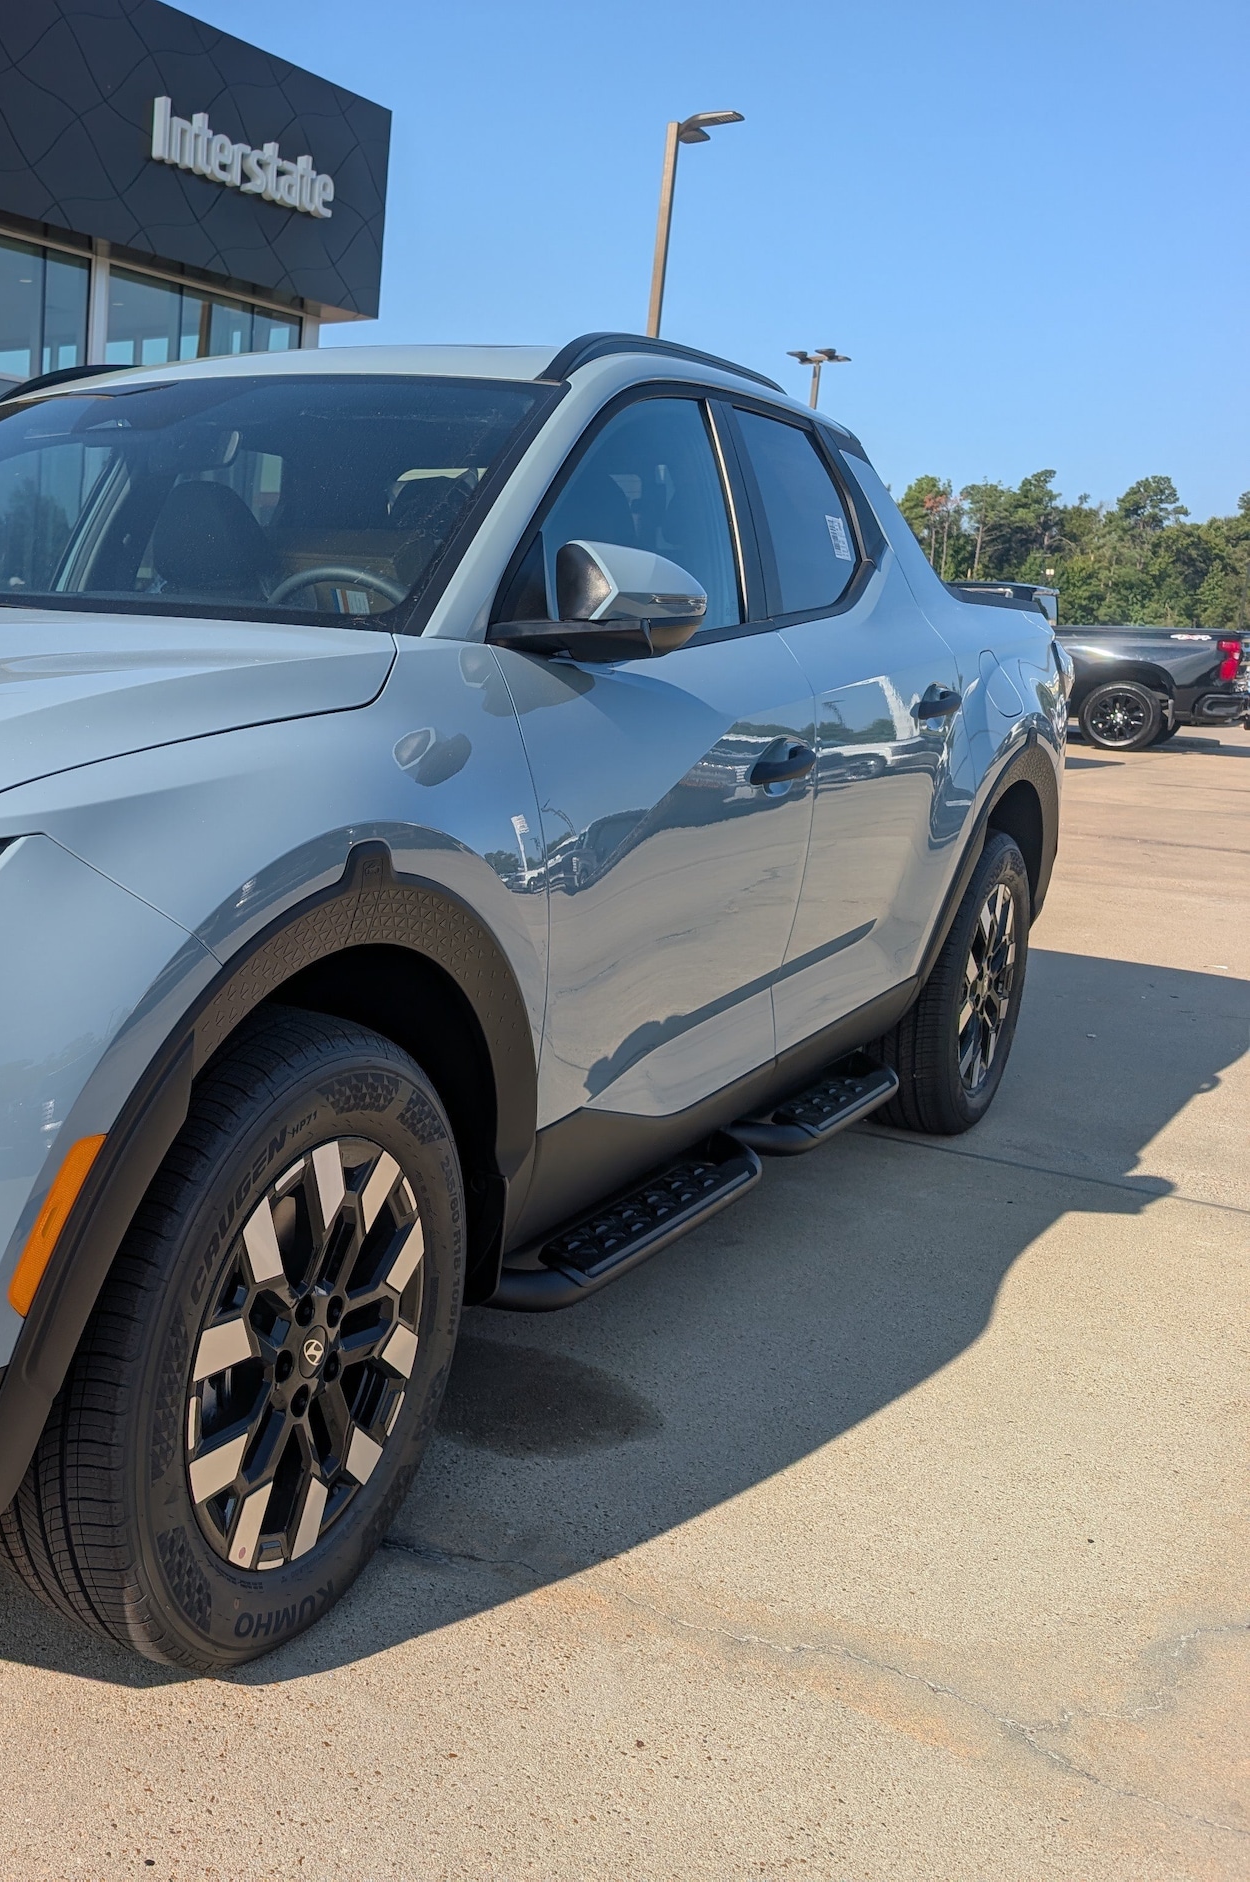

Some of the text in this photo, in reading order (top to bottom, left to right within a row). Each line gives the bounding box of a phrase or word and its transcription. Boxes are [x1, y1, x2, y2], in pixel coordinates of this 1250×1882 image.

[152, 96, 335, 219] Interstate
[191, 1110, 318, 1305] CRUGEN HP71
[234, 1579, 335, 1638] KUMHO
